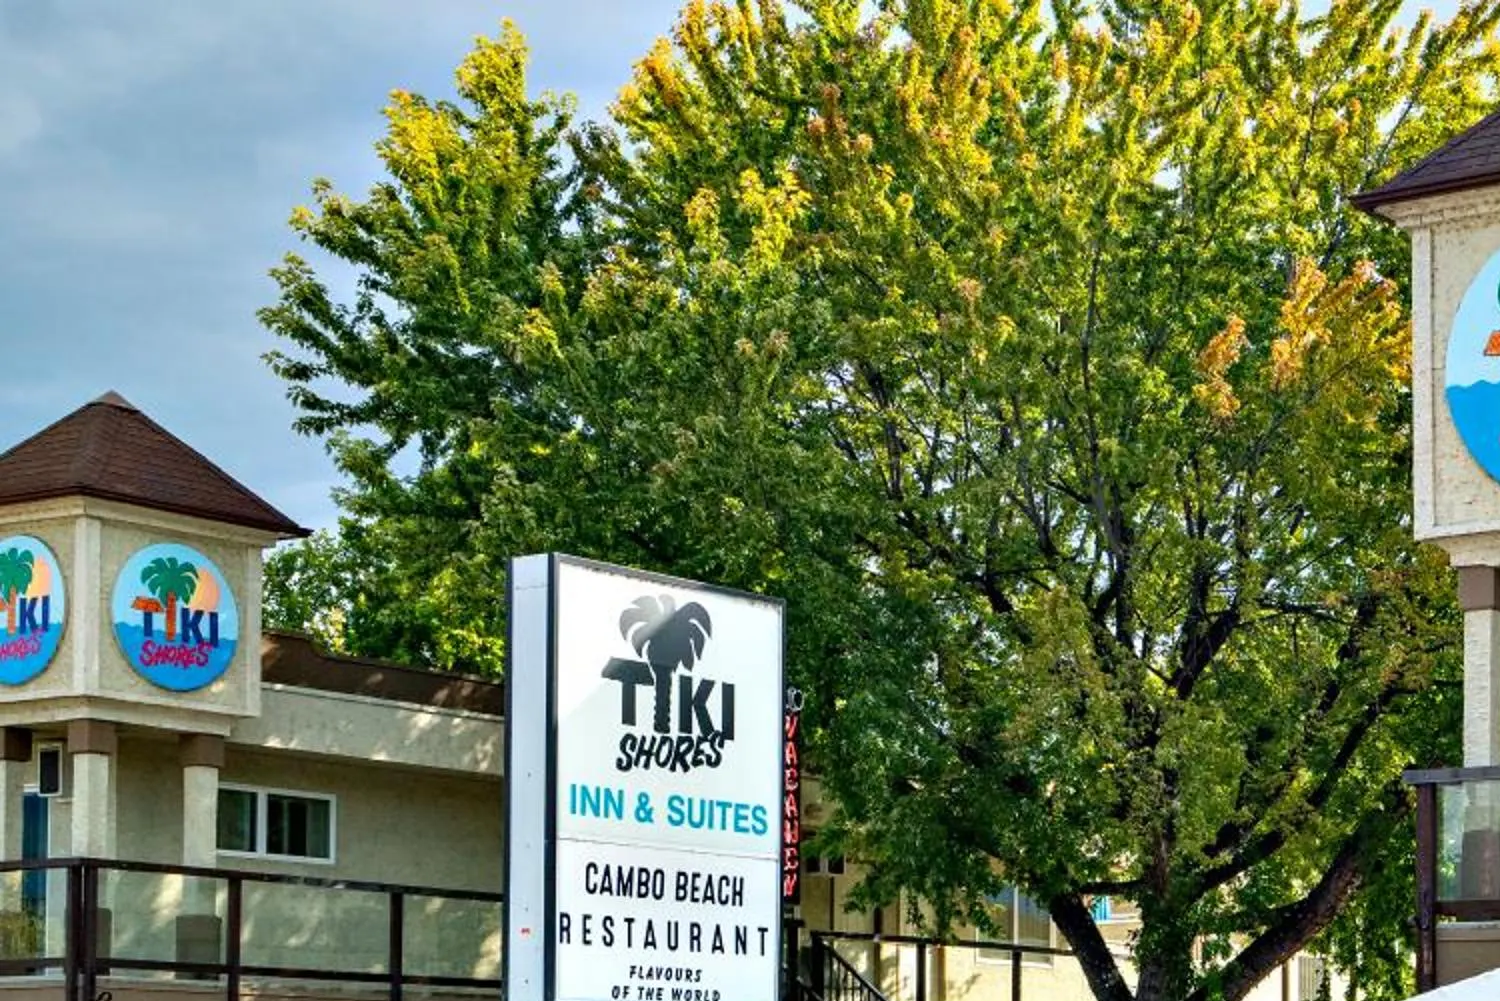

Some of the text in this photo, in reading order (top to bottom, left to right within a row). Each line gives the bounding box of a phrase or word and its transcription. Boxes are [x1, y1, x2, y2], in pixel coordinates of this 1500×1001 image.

[0, 595, 49, 635] IKI
[131, 592, 219, 647] TIKI
[139, 640, 212, 668] SHORES
[602, 656, 735, 741] TIKI
[616, 730, 725, 773] SHORES
[569, 783, 769, 837] INN & SUITES
[585, 862, 745, 907] CAMBO BEACH
[559, 912, 769, 957] RESTAURANT
[611, 985, 631, 1000] OF
[638, 986, 664, 1001] THE
[629, 965, 703, 983] FLAVOURS
